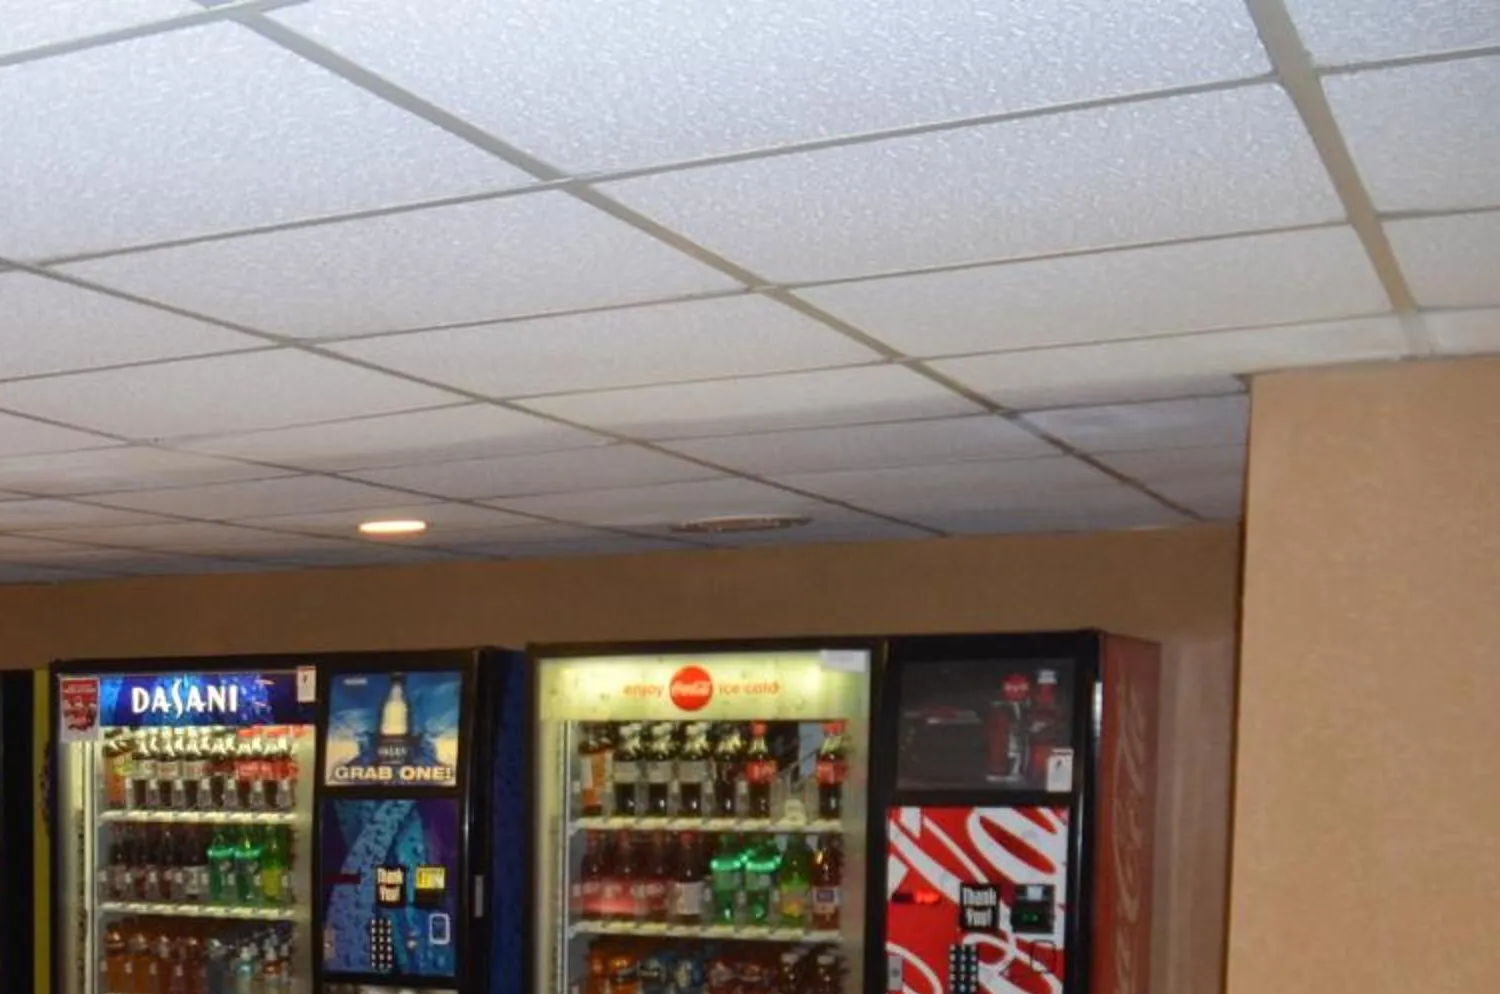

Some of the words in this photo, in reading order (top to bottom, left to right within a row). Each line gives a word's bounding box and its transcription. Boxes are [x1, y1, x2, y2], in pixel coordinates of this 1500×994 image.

[719, 682, 740, 695] ice
[744, 680, 780, 694] cold
[131, 678, 238, 719] DASANI
[334, 765, 393, 781] GRAB
[400, 765, 453, 781] ONE!
[963, 886, 997, 906] Thank
